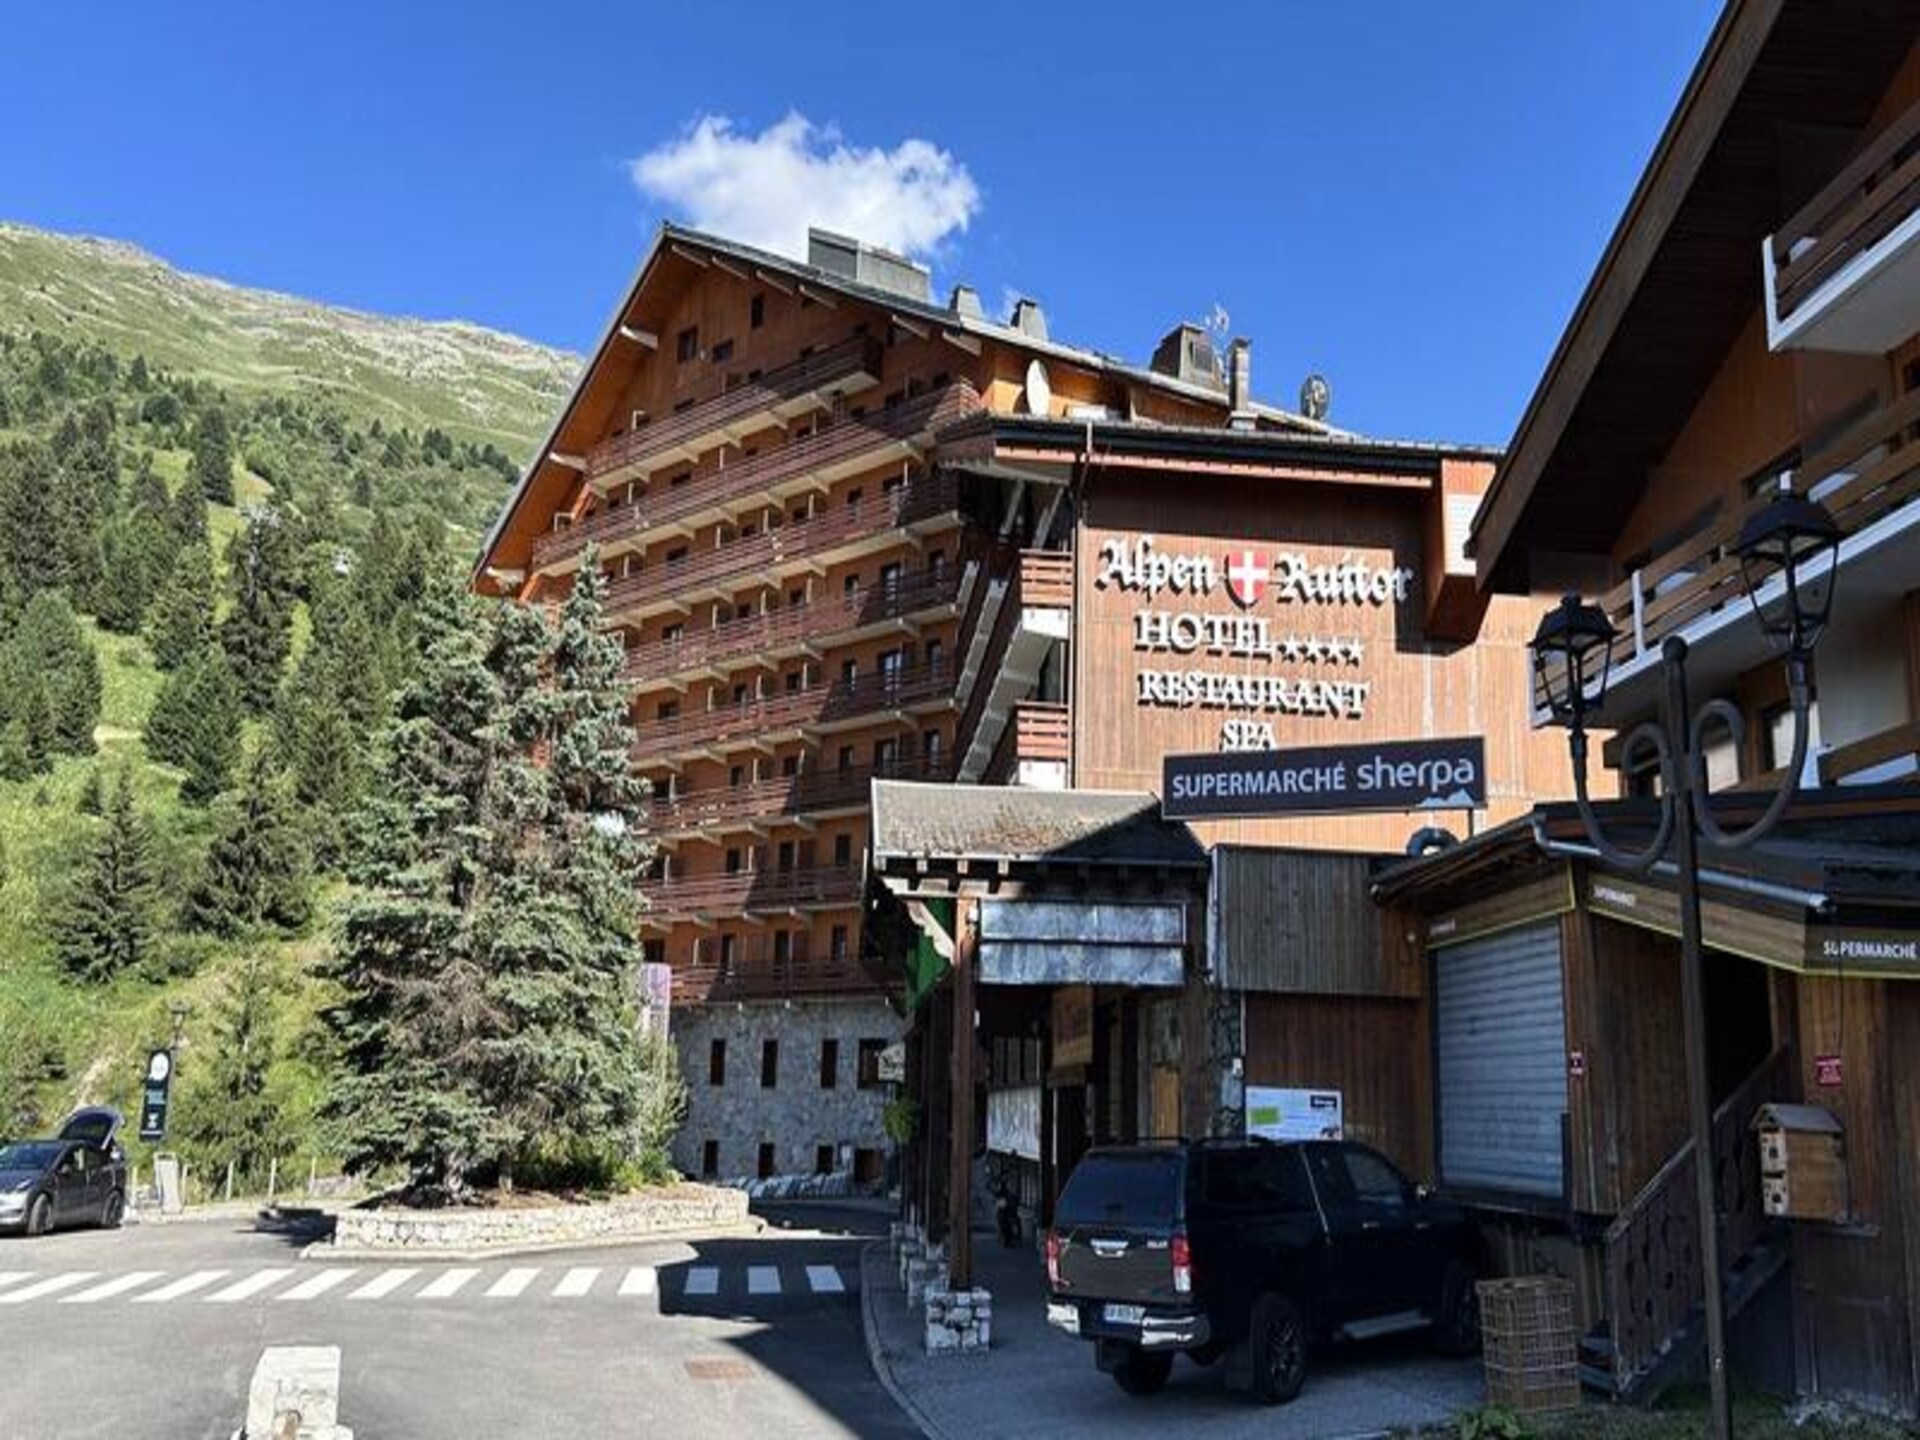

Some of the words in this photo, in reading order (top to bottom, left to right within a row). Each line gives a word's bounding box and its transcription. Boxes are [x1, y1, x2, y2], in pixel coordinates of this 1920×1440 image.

[1097, 534, 1218, 601] Alpen
[1275, 550, 1414, 603] Ruitor
[1137, 611, 1271, 655] HOTEL
[1139, 671, 1370, 715] RESTAURANT
[1222, 720, 1277, 752] SPA
[1172, 761, 1347, 798] SUPERMARCHÉ
[1357, 755, 1475, 792] sherpa
